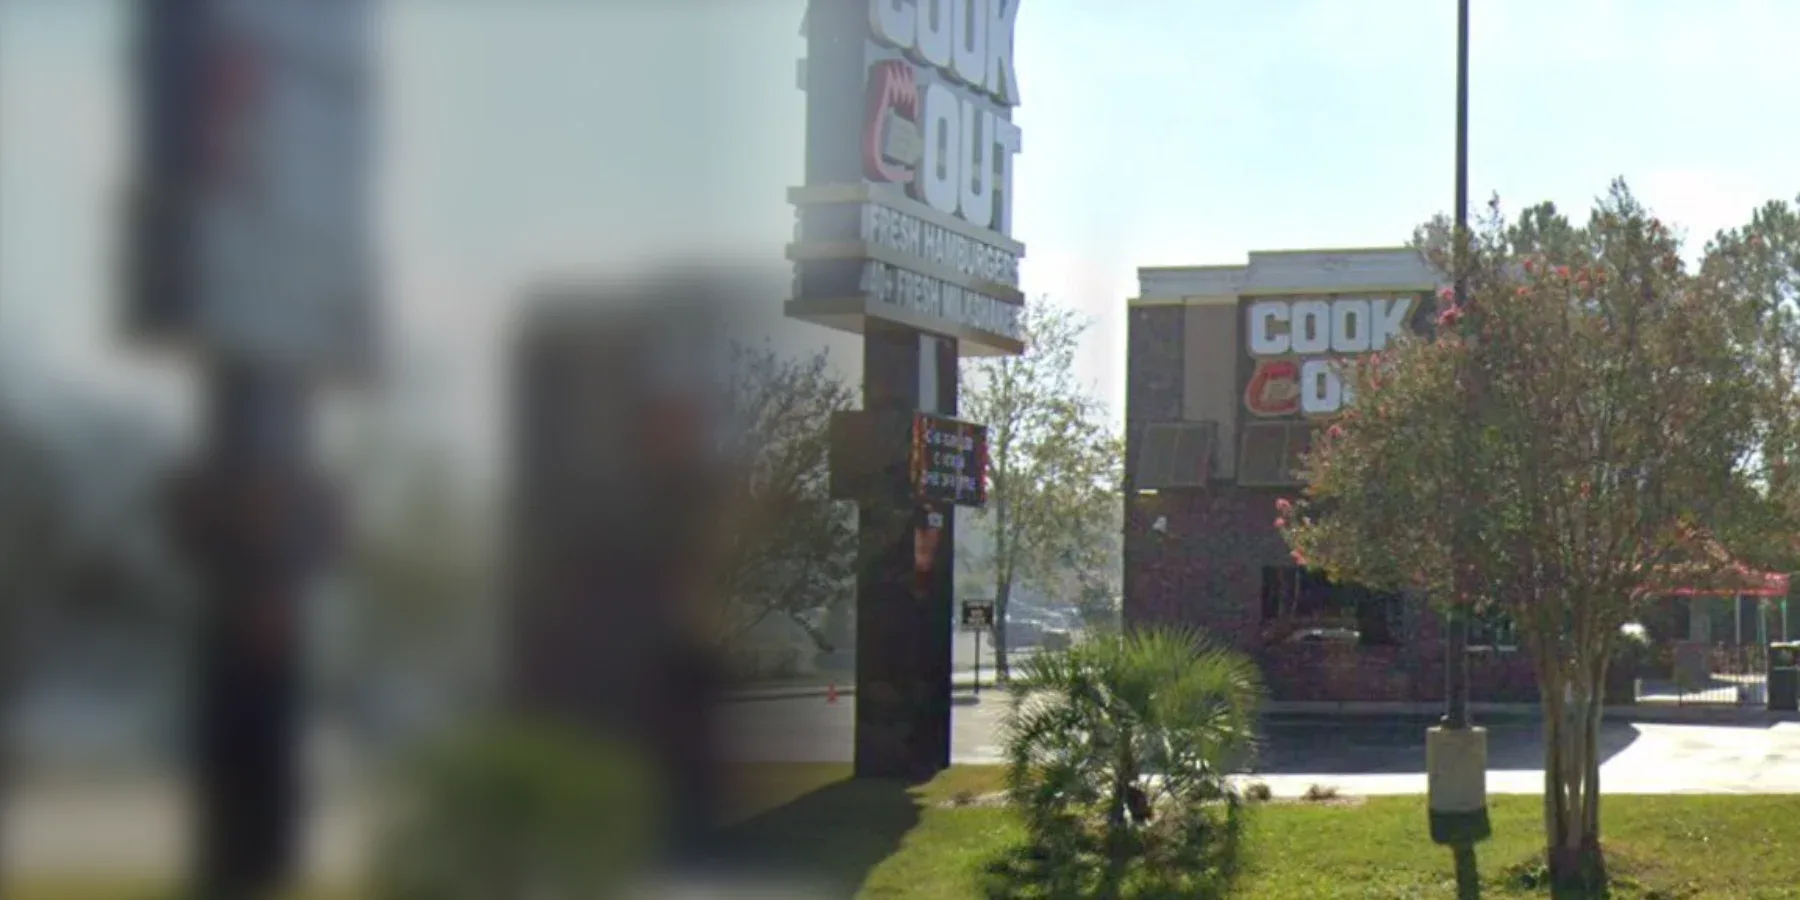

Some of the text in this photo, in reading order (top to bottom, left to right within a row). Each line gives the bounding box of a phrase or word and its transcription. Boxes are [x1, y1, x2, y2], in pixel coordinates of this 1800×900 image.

[923, 81, 1022, 240] OUT
[864, 204, 920, 256] FRESH
[898, 269, 940, 315] FRESH
[1249, 298, 1412, 354] COOK
